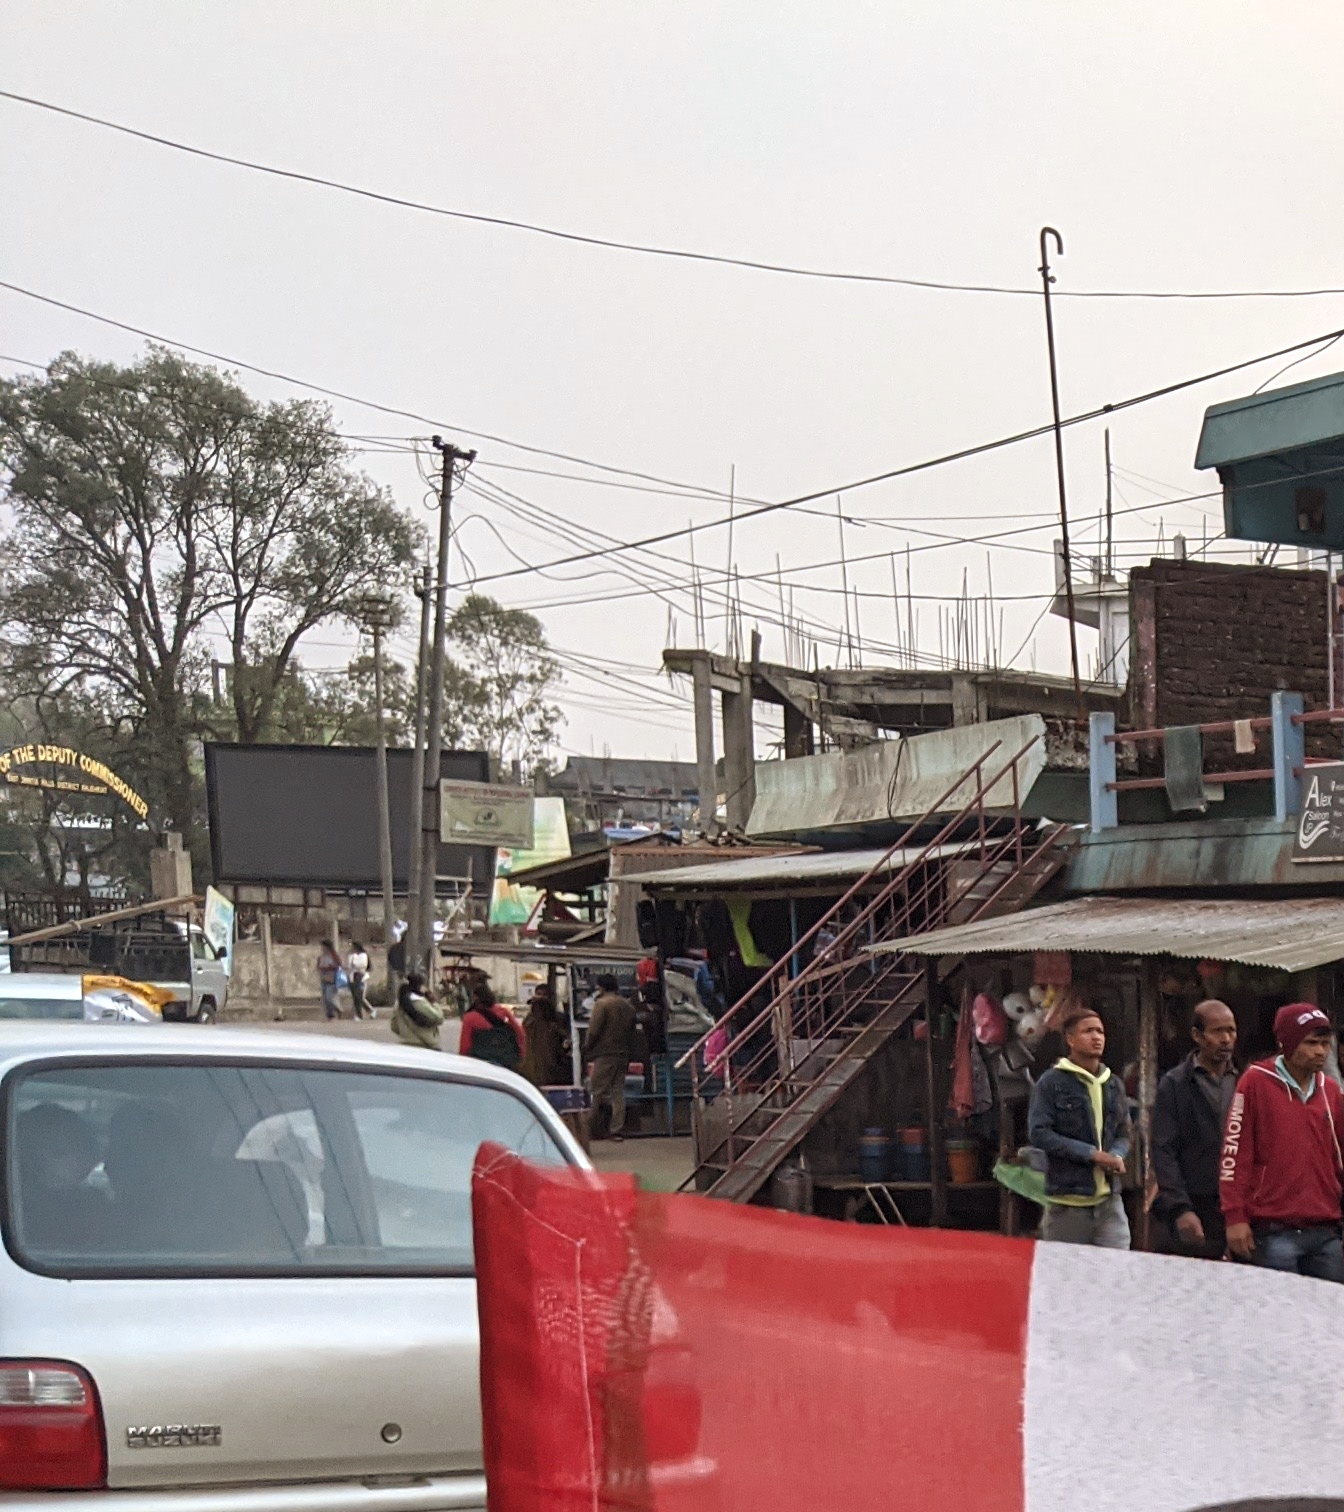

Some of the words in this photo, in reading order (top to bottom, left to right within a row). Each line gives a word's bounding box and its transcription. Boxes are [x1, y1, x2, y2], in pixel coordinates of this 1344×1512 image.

[12, 744, 35, 765] THE
[37, 744, 78, 767] DEPUTY
[80, 754, 149, 820] COMMISSIONER
[1304, 775, 1333, 808] Alex
[1221, 1106, 1245, 1156] MOVE
[1220, 1159, 1236, 1182] ON
